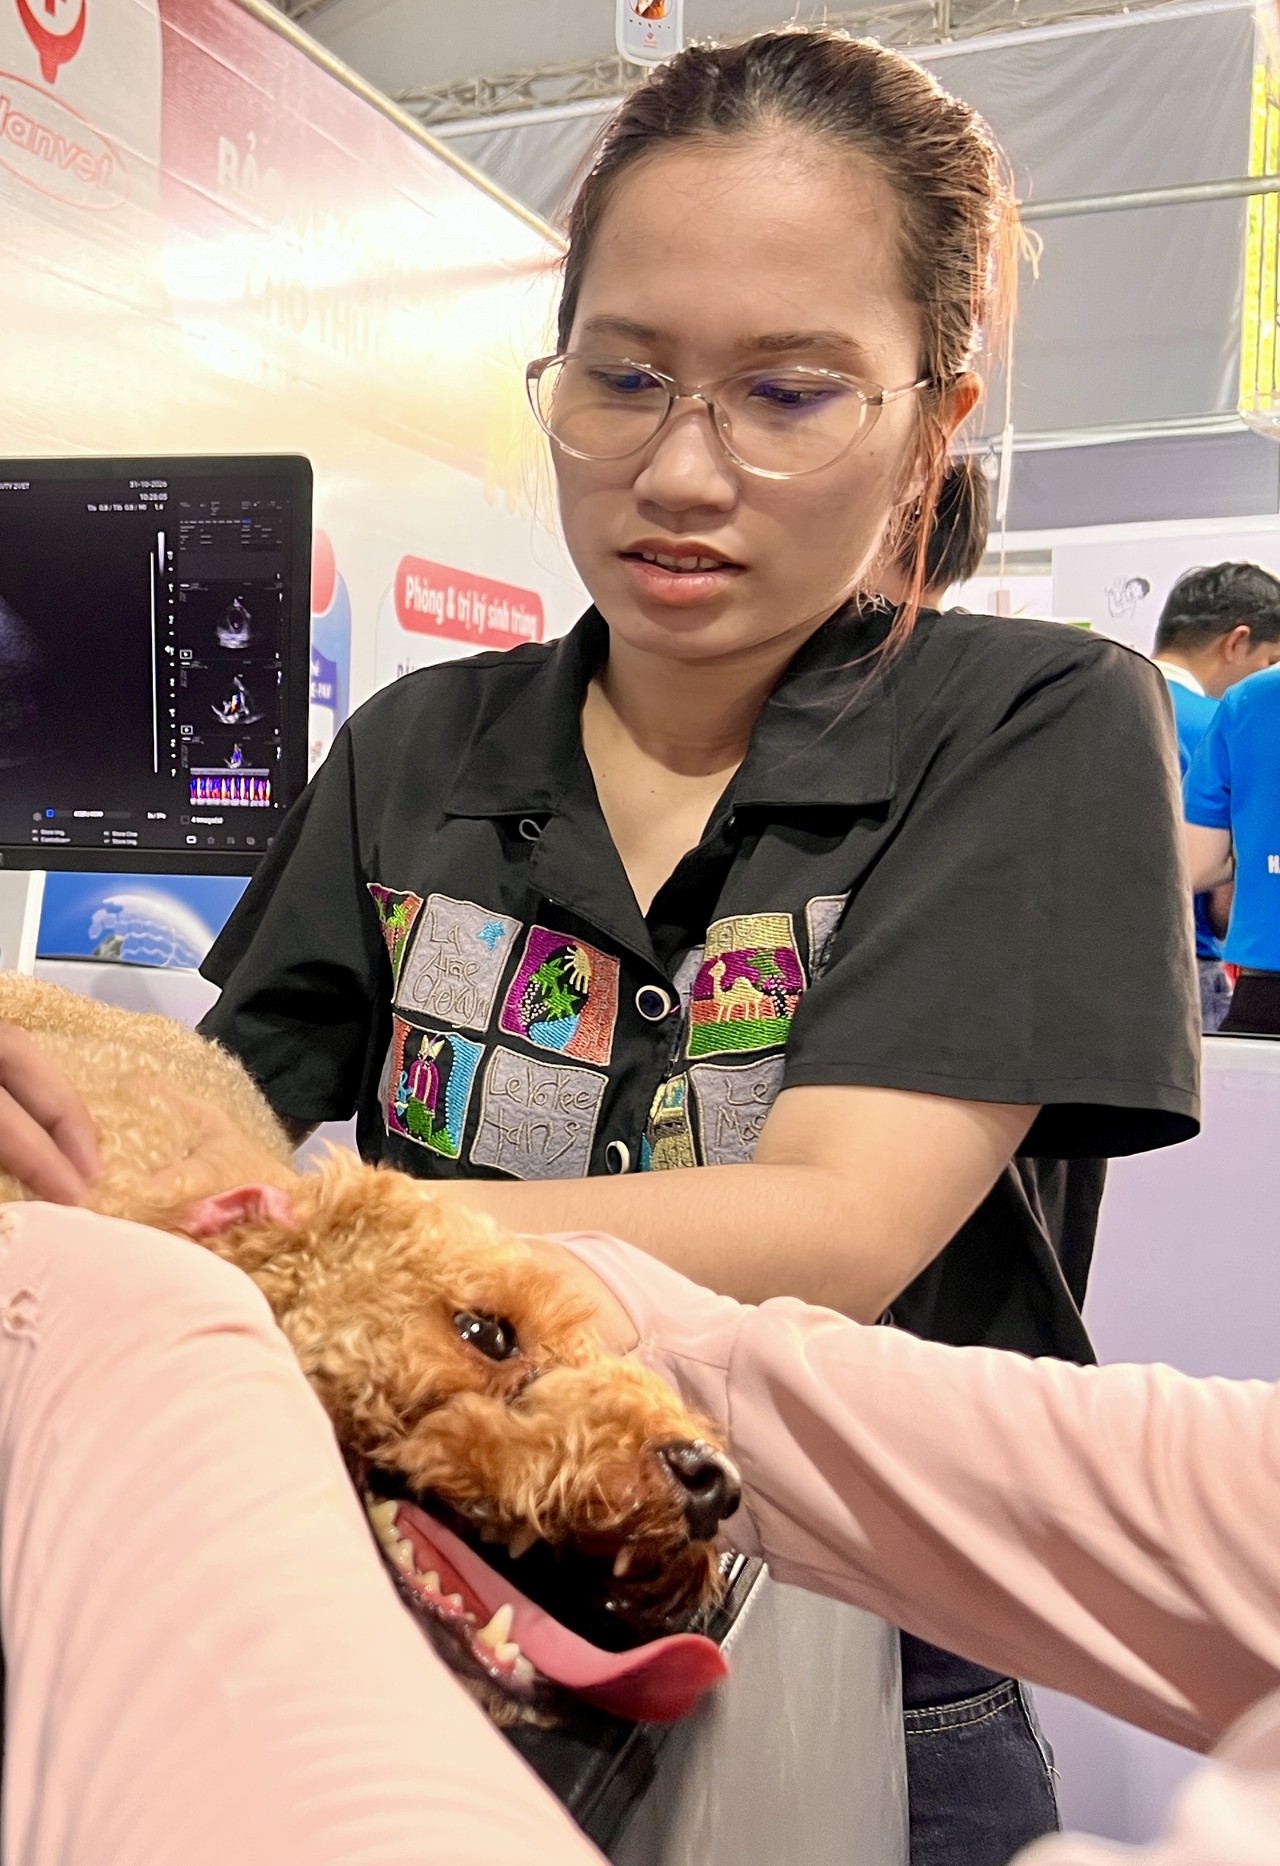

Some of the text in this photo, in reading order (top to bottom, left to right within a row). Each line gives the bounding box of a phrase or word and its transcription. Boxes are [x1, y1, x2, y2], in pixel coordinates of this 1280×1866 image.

[405, 575, 444, 625] Phòng
[446, 586, 456, 620] &
[457, 590, 471, 631] trị
[472, 591, 487, 635] ký
[487, 597, 510, 632] sinh
